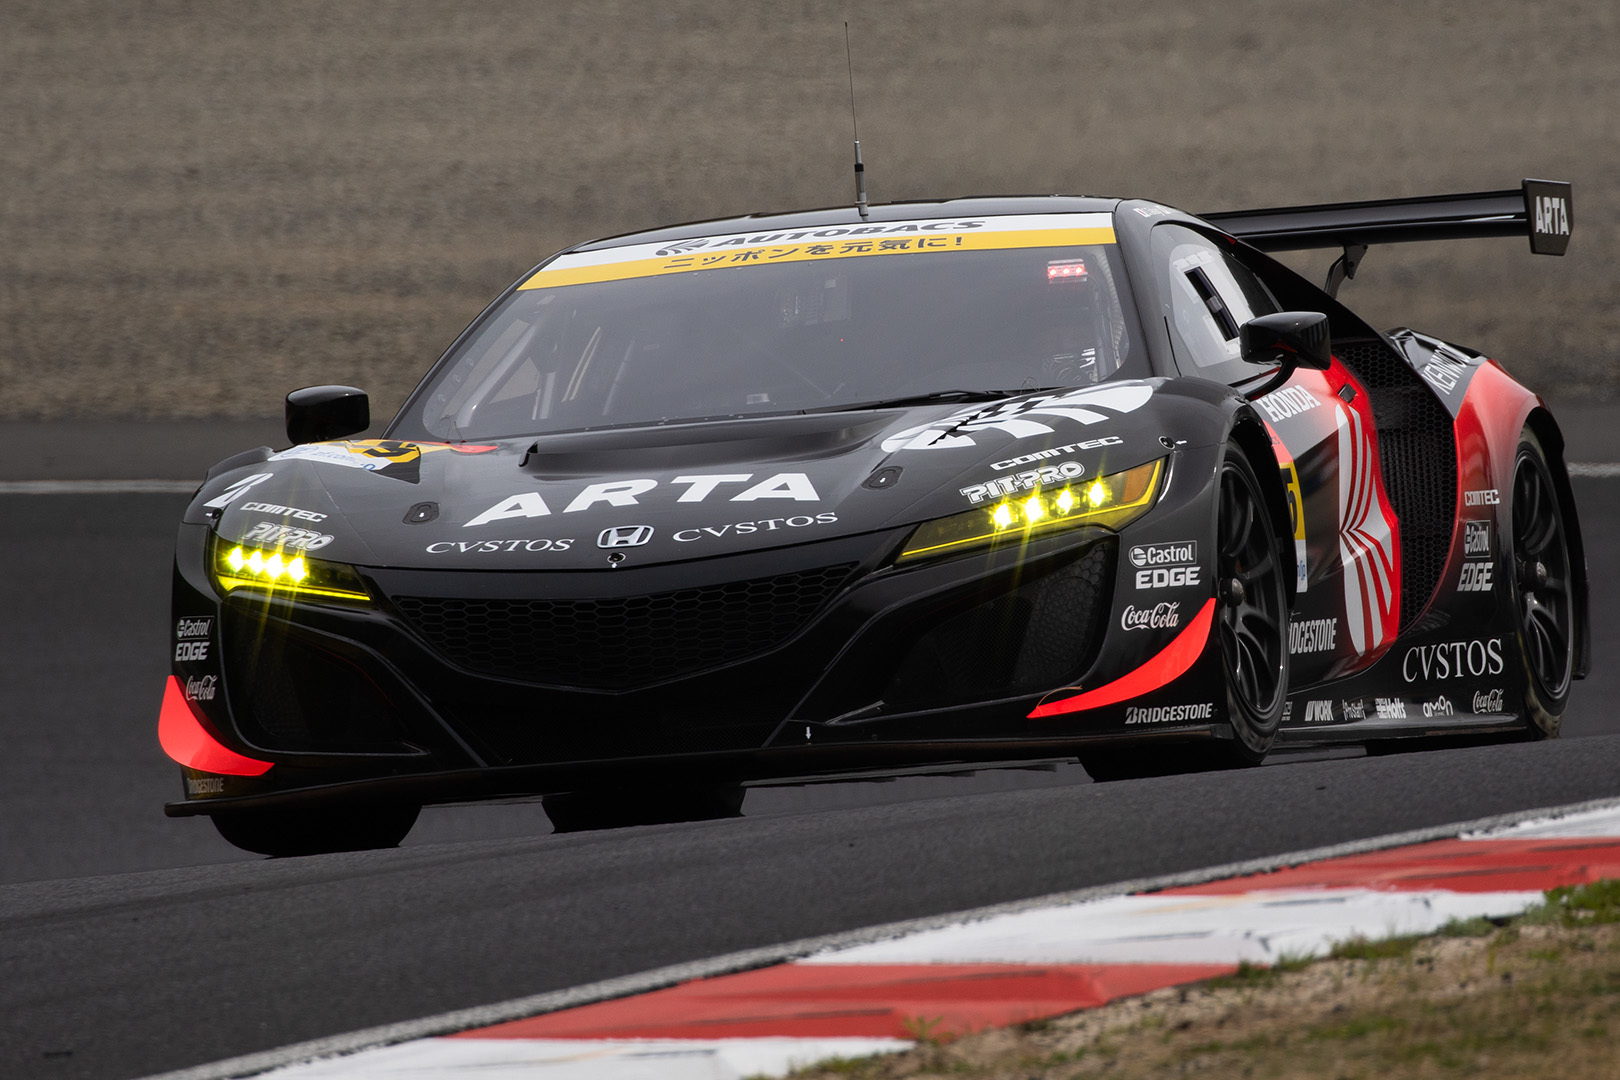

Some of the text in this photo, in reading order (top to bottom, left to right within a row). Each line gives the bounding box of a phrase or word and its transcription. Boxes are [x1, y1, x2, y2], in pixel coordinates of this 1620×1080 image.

[1535, 195, 1570, 236] ARTA
[707, 219, 987, 248] AUTOBACS
[1256, 384, 1321, 422] HONDA
[990, 436, 1124, 471] COMTEC
[462, 473, 821, 527] ARTA
[1464, 489, 1500, 507] COMTEC
[240, 501, 328, 523] COMTEC
[673, 512, 838, 542] CVSTOS
[1469, 527, 1490, 553] Castrol
[426, 538, 575, 555] CVSTOS
[1147, 544, 1194, 565] Castrol
[1135, 566, 1201, 590] EDGE
[1457, 563, 1494, 592] EDGE
[183, 618, 212, 637] Castrol
[1288, 617, 1338, 654] IDGESTONE
[175, 641, 211, 662] EDGE
[1402, 638, 1505, 683] CVSTOS
[1125, 702, 1213, 725] BRIDGESTONE
[1384, 697, 1407, 719] Holts
